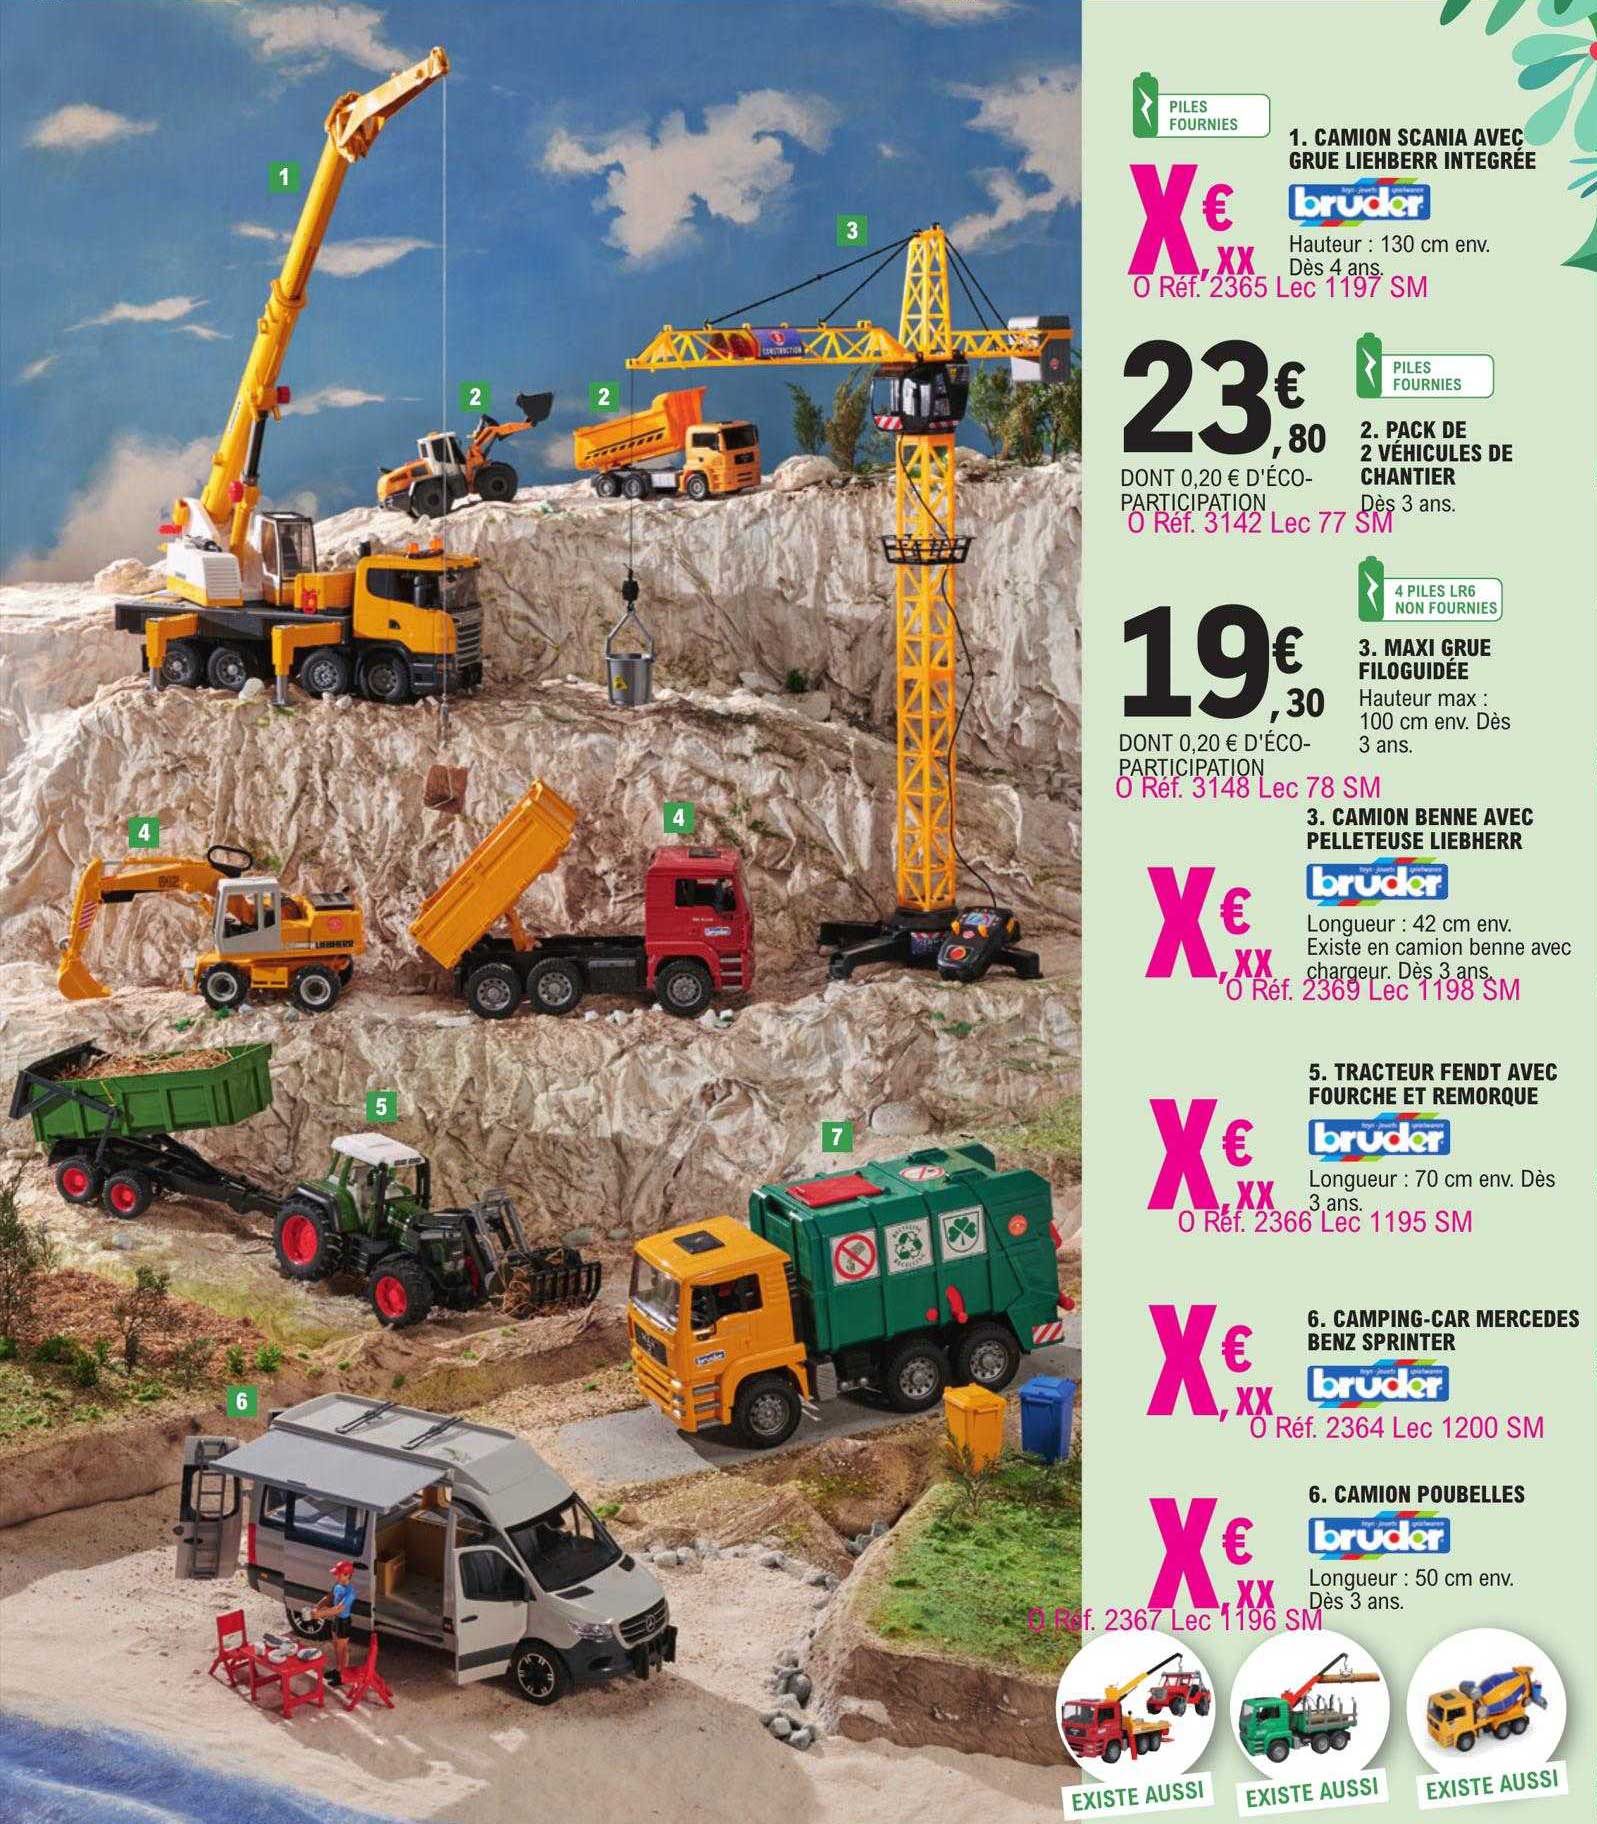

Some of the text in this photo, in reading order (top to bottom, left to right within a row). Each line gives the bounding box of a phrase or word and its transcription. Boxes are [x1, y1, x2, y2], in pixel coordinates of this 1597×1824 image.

[1169, 100, 1207, 113] PILES
[1169, 119, 1237, 130] FOURNIES
[1289, 128, 1524, 147] 1. CAMION SCANIA AVEC
[1289, 146, 1536, 170] GRUE LIEHBERR INTEGRÉE
[1294, 186, 1424, 218] bruder
[1290, 234, 1490, 253] Hauteur 130 cm env.
[1290, 257, 1384, 278] Dès 4 ans.
[1393, 362, 1429, 374] PILES
[1393, 378, 1461, 391] FOURNIES
[1360, 420, 1467, 439] 2. PACK DE
[1360, 439, 1513, 463] 2 VÉHICULES DE
[1121, 468, 1175, 487] DONT
[1181, 468, 1222, 490] 0,20
[1227, 468, 1240, 487] €
[1360, 467, 1456, 486] CHANTIER
[1121, 493, 1266, 512] PARTICIPATION
[1361, 494, 1456, 513] Dès 3 ans.
[1153, 510, 1393, 534] Réf. 3142 Lec 77 SM
[1394, 585, 1475, 598] 4 PILES LR6
[1395, 601, 1496, 614] NON FOURNIES
[1358, 638, 1491, 657] 3. MAXI GRUE
[1359, 658, 1469, 681] FILOGUIDÉE
[1359, 688, 1477, 707] Hauteur max
[1360, 711, 1511, 730] 100 cm env. Dès
[1119, 733, 1174, 752] DONT
[1179, 733, 1220, 755] 0,20
[1225, 733, 1238, 752] €
[1359, 735, 1413, 754] 3 ans.
[1119, 758, 1264, 777] PARTICIPATION
[1141, 775, 1381, 800] Réf. 3148 Lec 78 SM
[1306, 807, 1534, 826] 3. CAMION BENNE AVEC
[1307, 831, 1523, 850] PELLETEUSE LIEBHERR
[1312, 866, 1442, 898] bruder
[1307, 914, 1512, 937] Longueur 42 cm env.
[1307, 937, 1572, 956] Existe en camion benne avec
[1306, 961, 1494, 985] chargeur. Dès 3 ans.
[1309, 1062, 1558, 1082] 5. TRACTEUR FENDT AVEC
[1309, 1086, 1539, 1107] FOURCHE ET REMORQUE
[1314, 1121, 1444, 1153] bruder
[1309, 1169, 1556, 1193] Longueur 70 cm env. Dès
[1309, 1193, 1363, 1212] 3 ans.
[1307, 1309, 1580, 1328] 6. CAMPING-CAR MERCEDES
[1308, 1332, 1456, 1351] BENZ SPRINTER
[1312, 1367, 1442, 1399] bruder
[1276, 1415, 1544, 1440] Réf. 2364 Lec 1200 SM
[1308, 1484, 1525, 1504] 6. CAMION POUBELLES
[1314, 1519, 1444, 1551] bruder
[1309, 1568, 1514, 1592] Longueur 50 cm env.
[1309, 1591, 1404, 1610] Dès 3 ans.
[1320, 1776, 1377, 1800] AUSSI
[1426, 1776, 1491, 1800] EXISTE
[1499, 1770, 1558, 1793] AUSSI
[1072, 1787, 1137, 1811] EXISTE
[1146, 1782, 1204, 1803] AUSSI
[1246, 1783, 1312, 1808] EXISTE
